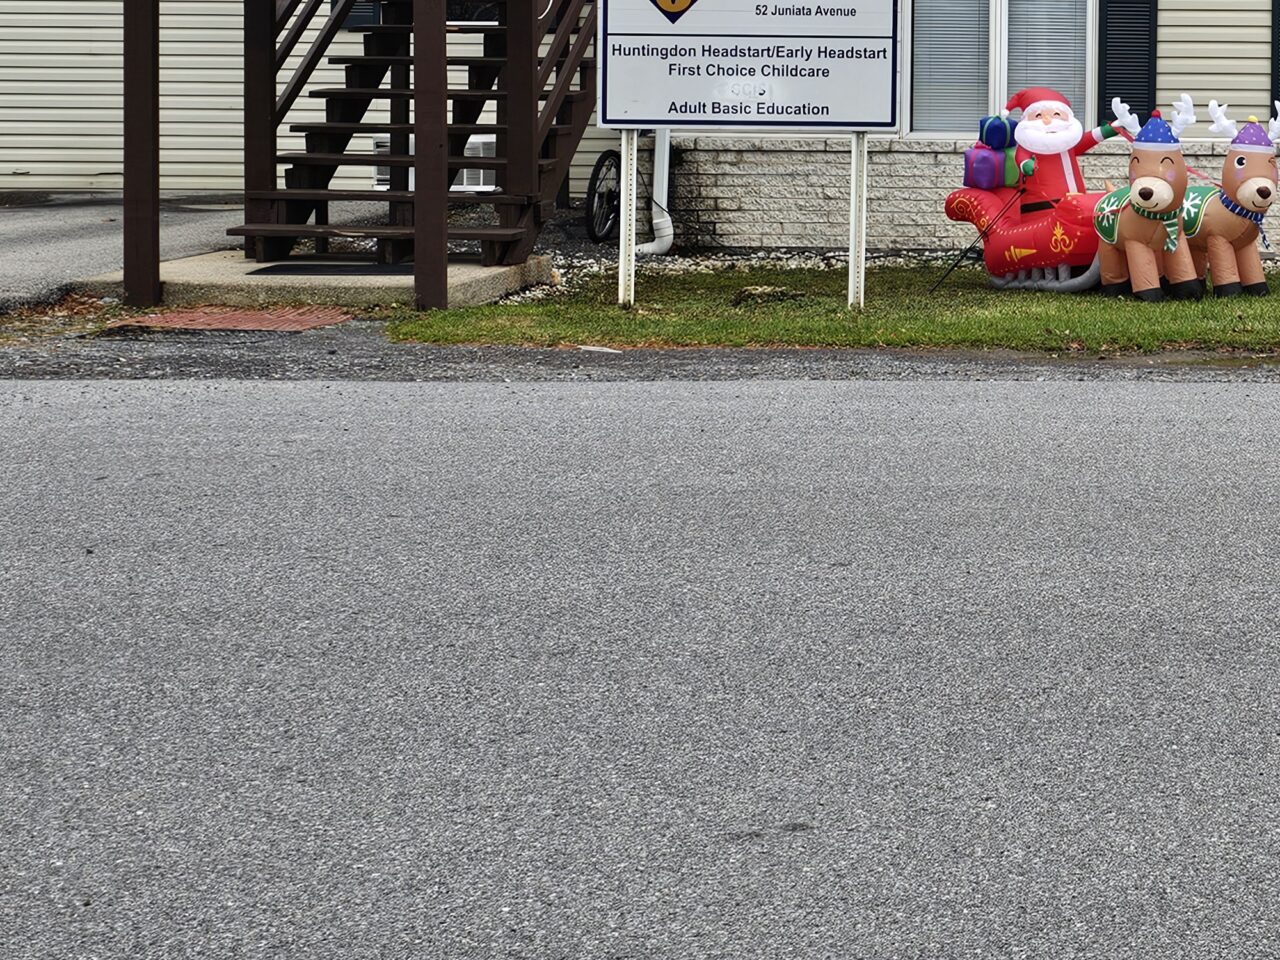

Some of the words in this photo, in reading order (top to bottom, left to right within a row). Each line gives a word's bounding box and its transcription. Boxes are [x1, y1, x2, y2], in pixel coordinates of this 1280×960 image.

[755, 4, 768, 16] 52
[771, 4, 812, 16] Juniata
[814, 5, 857, 17] Avenue
[611, 43, 697, 59] Huntingdon
[701, 44, 813, 62] Headstart/Early
[817, 45, 888, 60] Headstart
[668, 63, 701, 77] First
[705, 63, 756, 77] Choice
[760, 64, 830, 78] Childcare
[667, 101, 707, 115] Adult
[711, 101, 752, 115] Basic
[756, 102, 830, 116] Education
